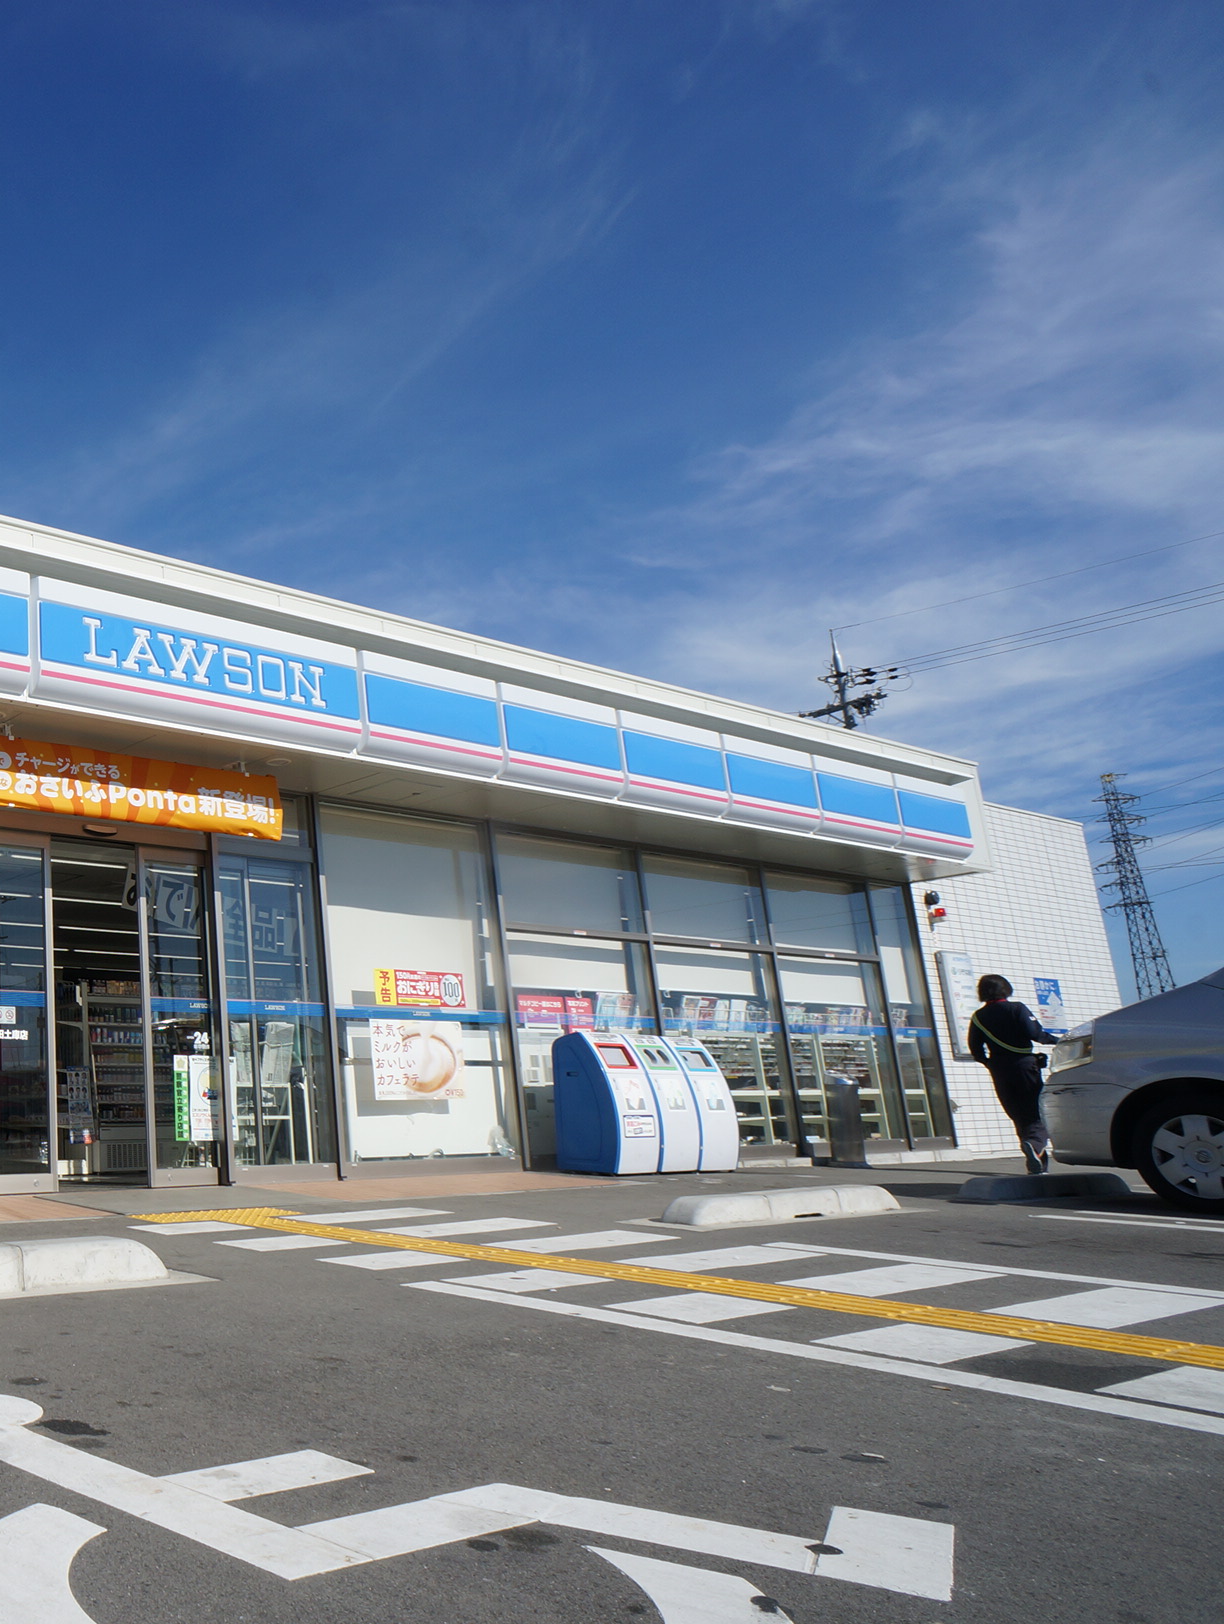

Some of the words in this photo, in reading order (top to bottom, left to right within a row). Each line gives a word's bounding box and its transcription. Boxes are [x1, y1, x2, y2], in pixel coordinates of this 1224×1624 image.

[82, 616, 327, 709] LAWSON
[15, 752, 120, 779] チャージができる
[14, 769, 276, 824] おさいふPonta新登場!
[379, 970, 391, 1003] 予告
[396, 979, 434, 996] おにぎり
[443, 981, 460, 998] 100
[193, 1031, 210, 1045] 24
[374, 1040, 413, 1053] ミルクが
[376, 1058, 416, 1070] おいしい
